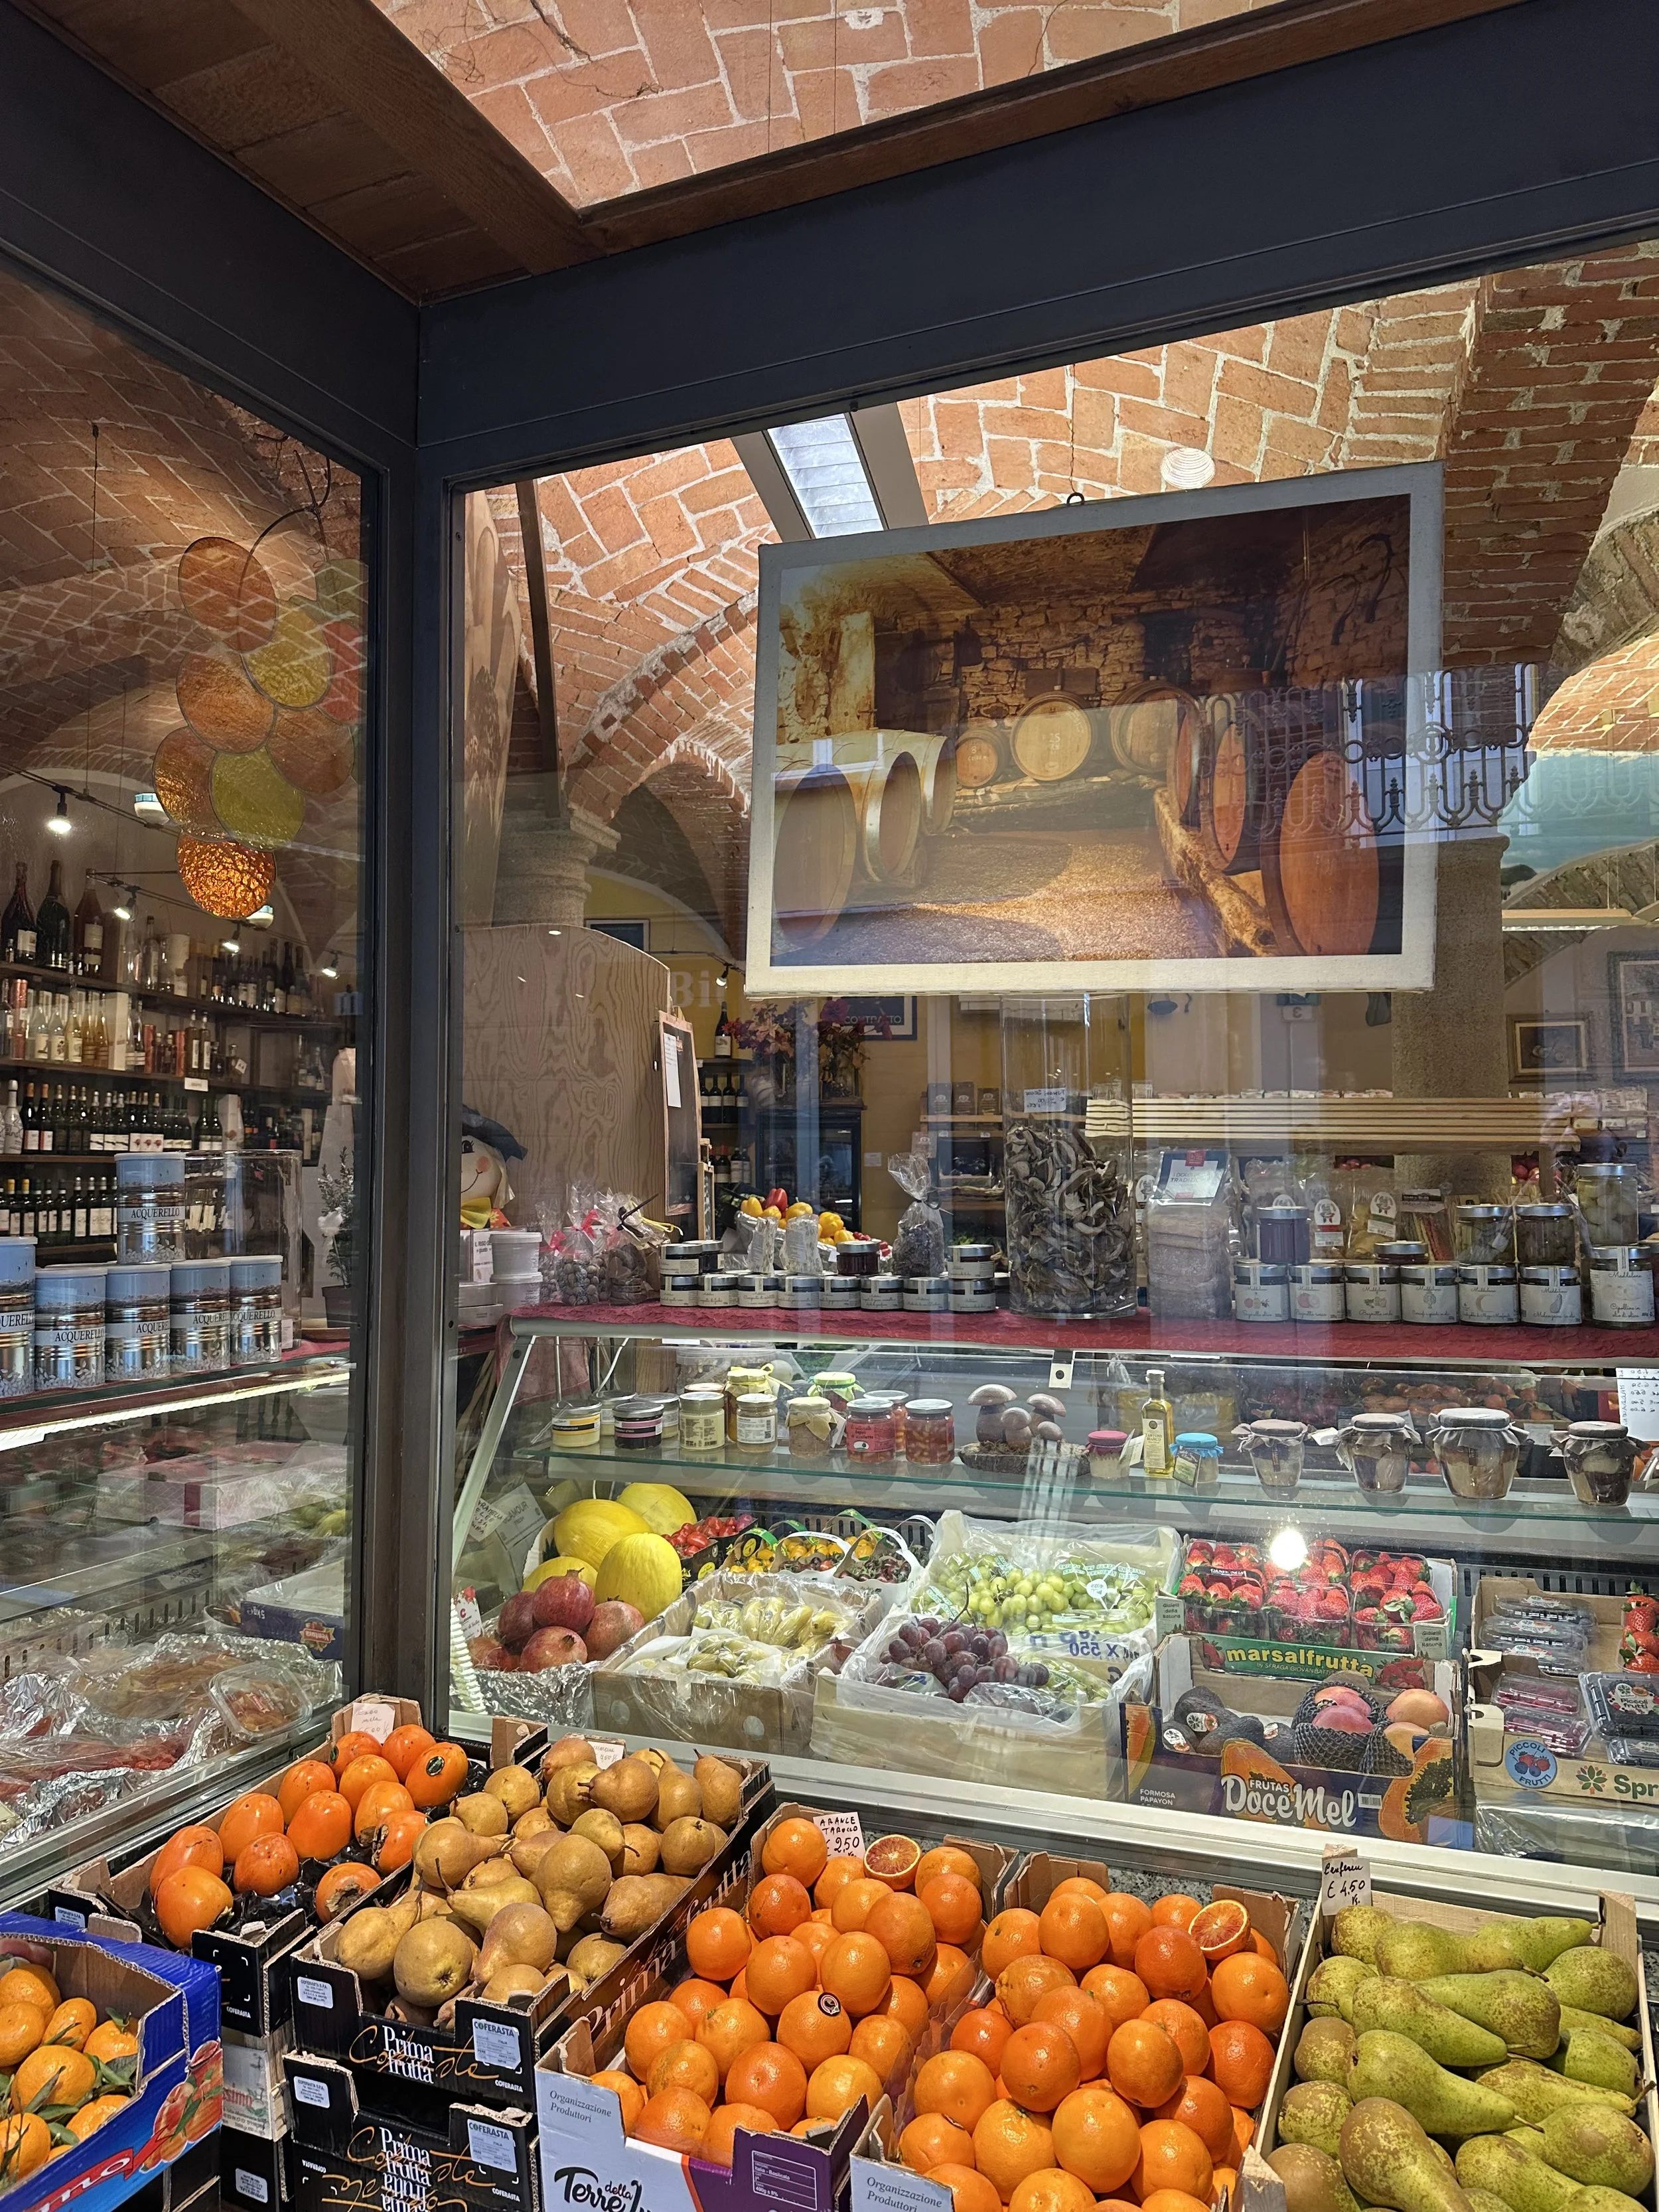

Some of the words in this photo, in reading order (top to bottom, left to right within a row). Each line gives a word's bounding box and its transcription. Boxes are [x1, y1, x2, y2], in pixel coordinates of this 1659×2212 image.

[131, 1207, 180, 1219] ACQUERELLO
[1226, 1647, 1374, 1678] marsalfrutta
[1510, 1742, 1546, 1756] PICCOLI
[1249, 1779, 1289, 1793] FRUTAS
[1519, 1773, 1551, 1787] FRUTTI
[1139, 1788, 1176, 1799] FORMOSA
[1140, 1795, 1173, 1806] PAPAYON
[820, 1816, 856, 1826] ARANCE
[1327, 1880, 1336, 1899] €
[226, 2006, 251, 2019] COFERASTA
[474, 2021, 515, 2038] COFERASTA
[382, 2025, 435, 2063] Prima
[388, 2045, 435, 2084] frutta
[494, 2079, 524, 2093] COFERASTA
[549, 2090, 612, 2117] Organizzazione
[550, 2102, 593, 2123] Produttori
[469, 2122, 510, 2140] COFERASTA
[379, 2126, 432, 2168] Prima
[386, 2151, 432, 2187] frutta
[492, 2187, 521, 2202] COFERASTA
[554, 2166, 626, 2212] Terre
[605, 2181, 634, 2200] della
[867, 2176, 942, 2208] Organizzazione
[867, 2190, 918, 2212] Produttori
